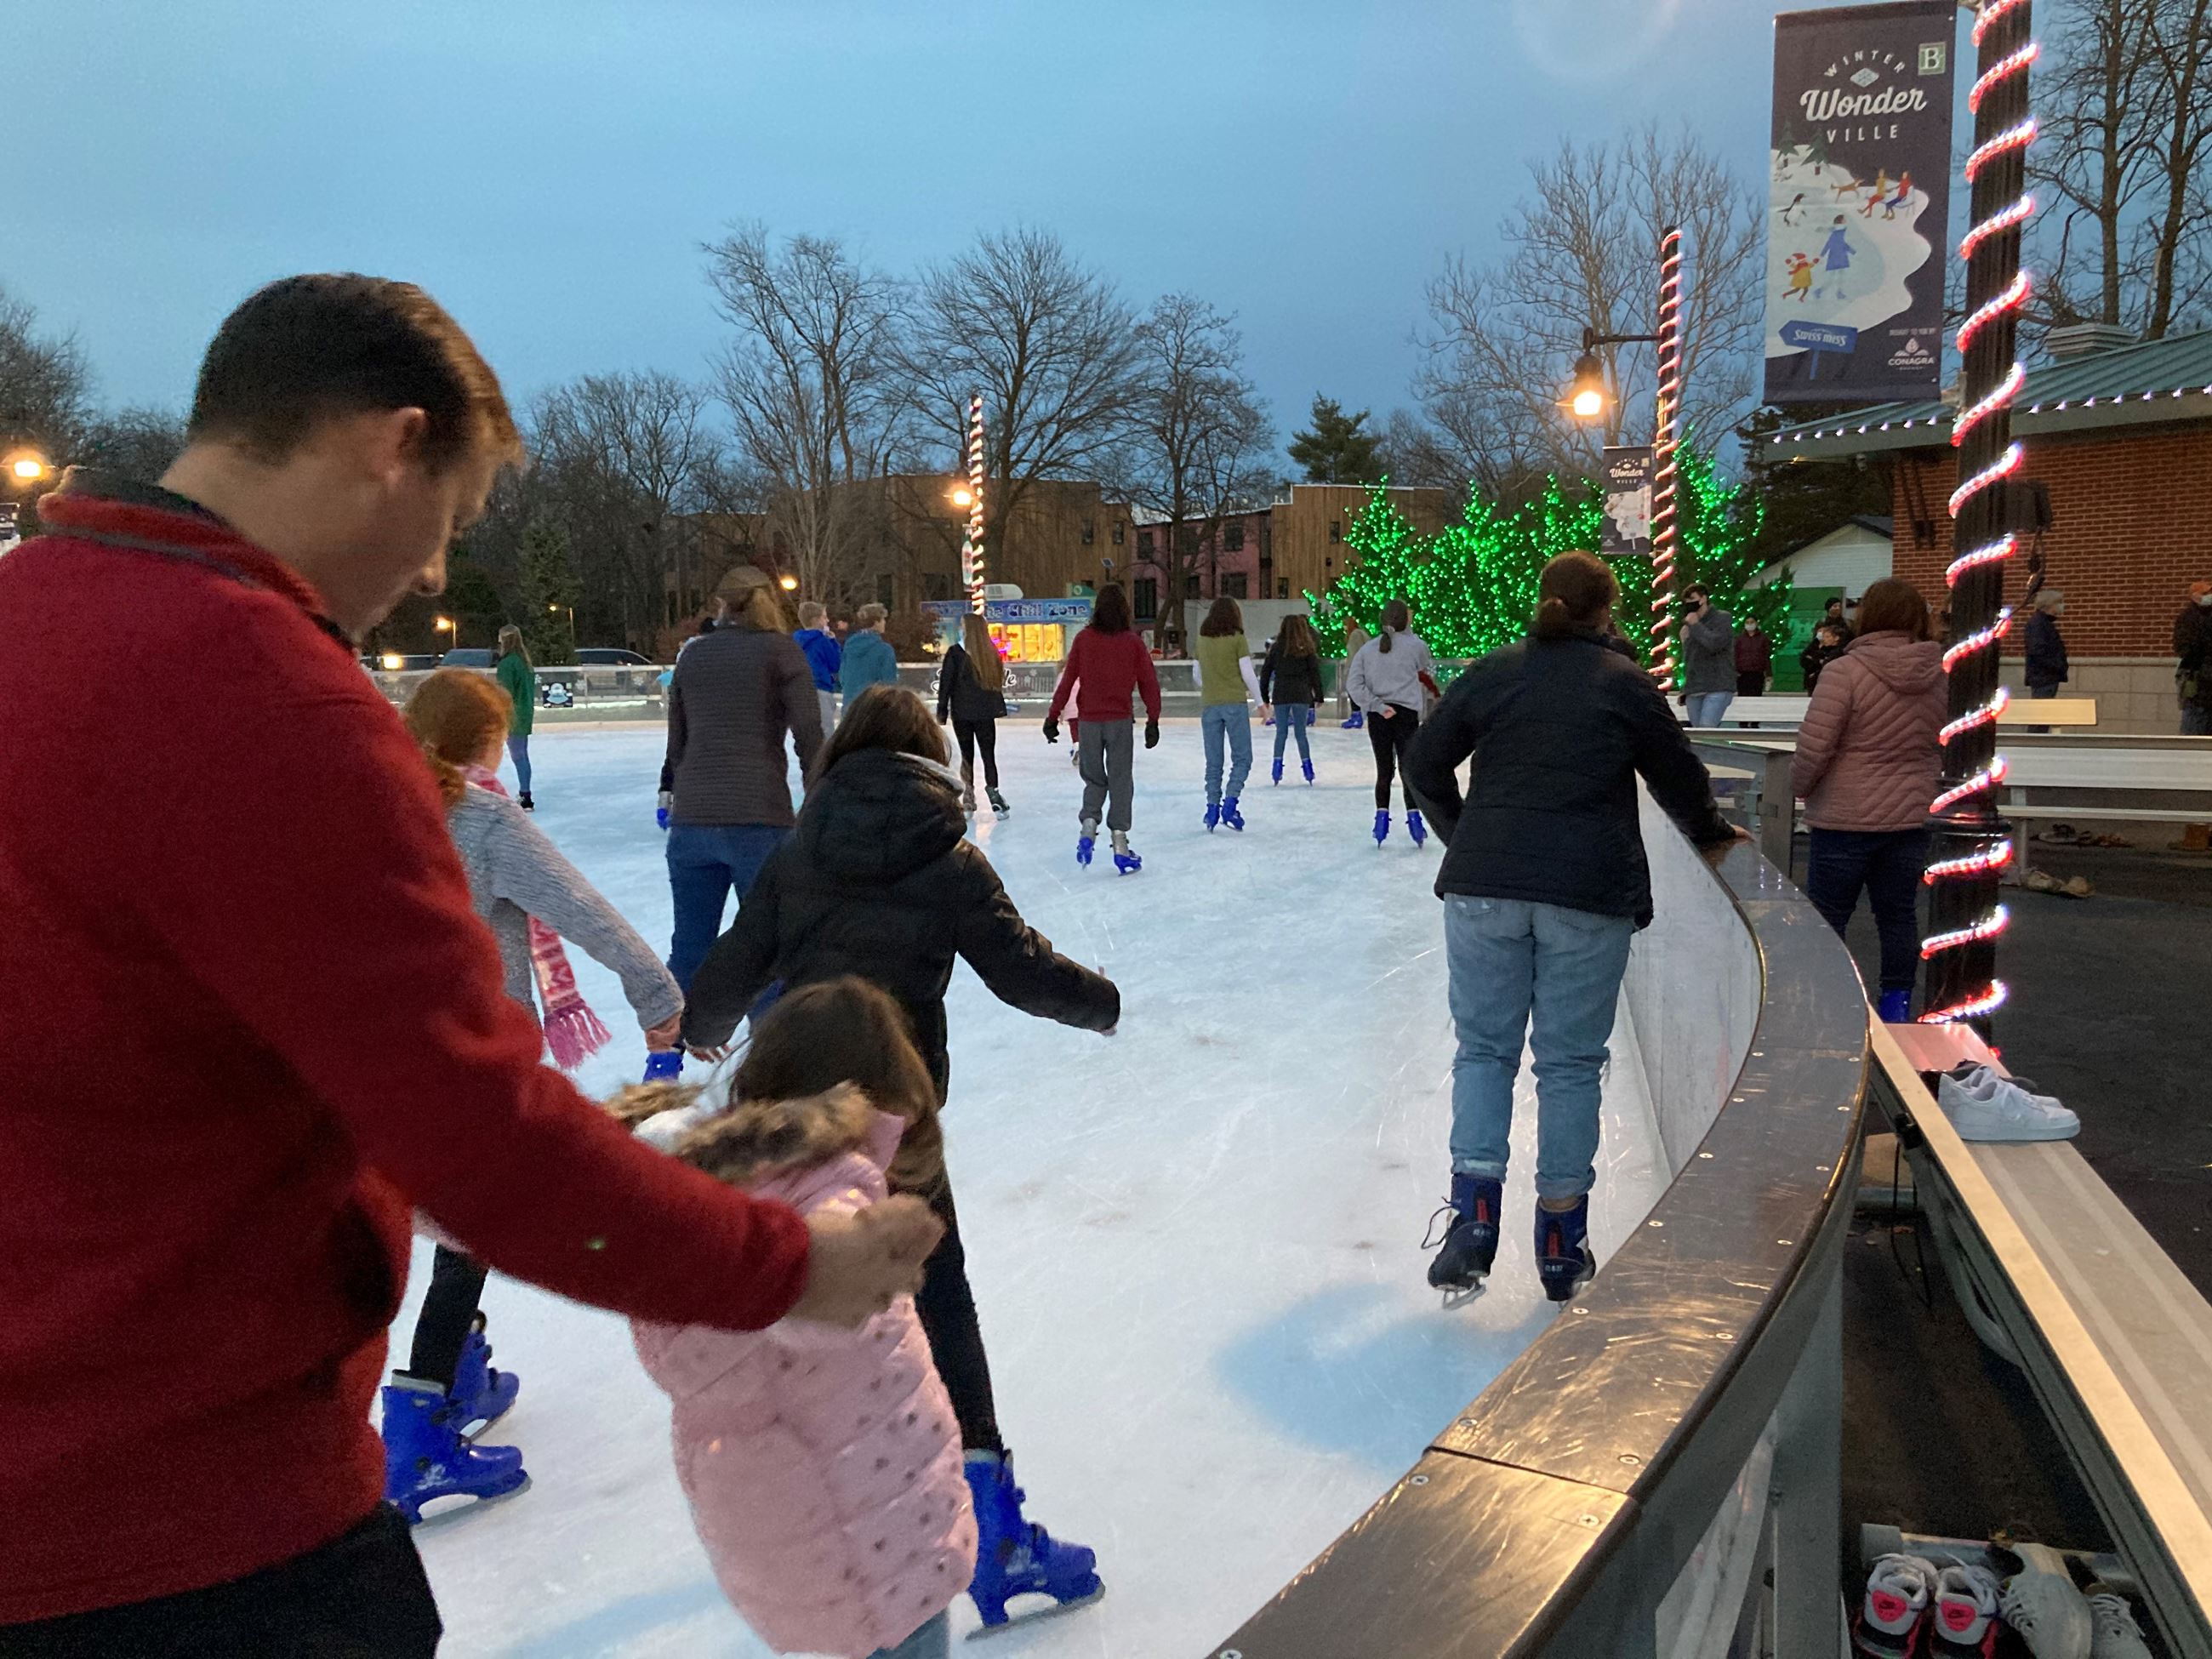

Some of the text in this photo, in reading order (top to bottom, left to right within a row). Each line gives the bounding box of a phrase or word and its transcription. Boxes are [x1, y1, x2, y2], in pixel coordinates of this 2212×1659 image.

[1824, 50, 1906, 77] WINTER
[1920, 47, 1941, 70] B
[1799, 86, 1928, 121] Wonder
[1827, 124, 1898, 144] VILLE
[1888, 357, 1935, 366] CONAGRA
[1609, 468, 1645, 478] Wonder
[1046, 601, 1087, 617] Zone
